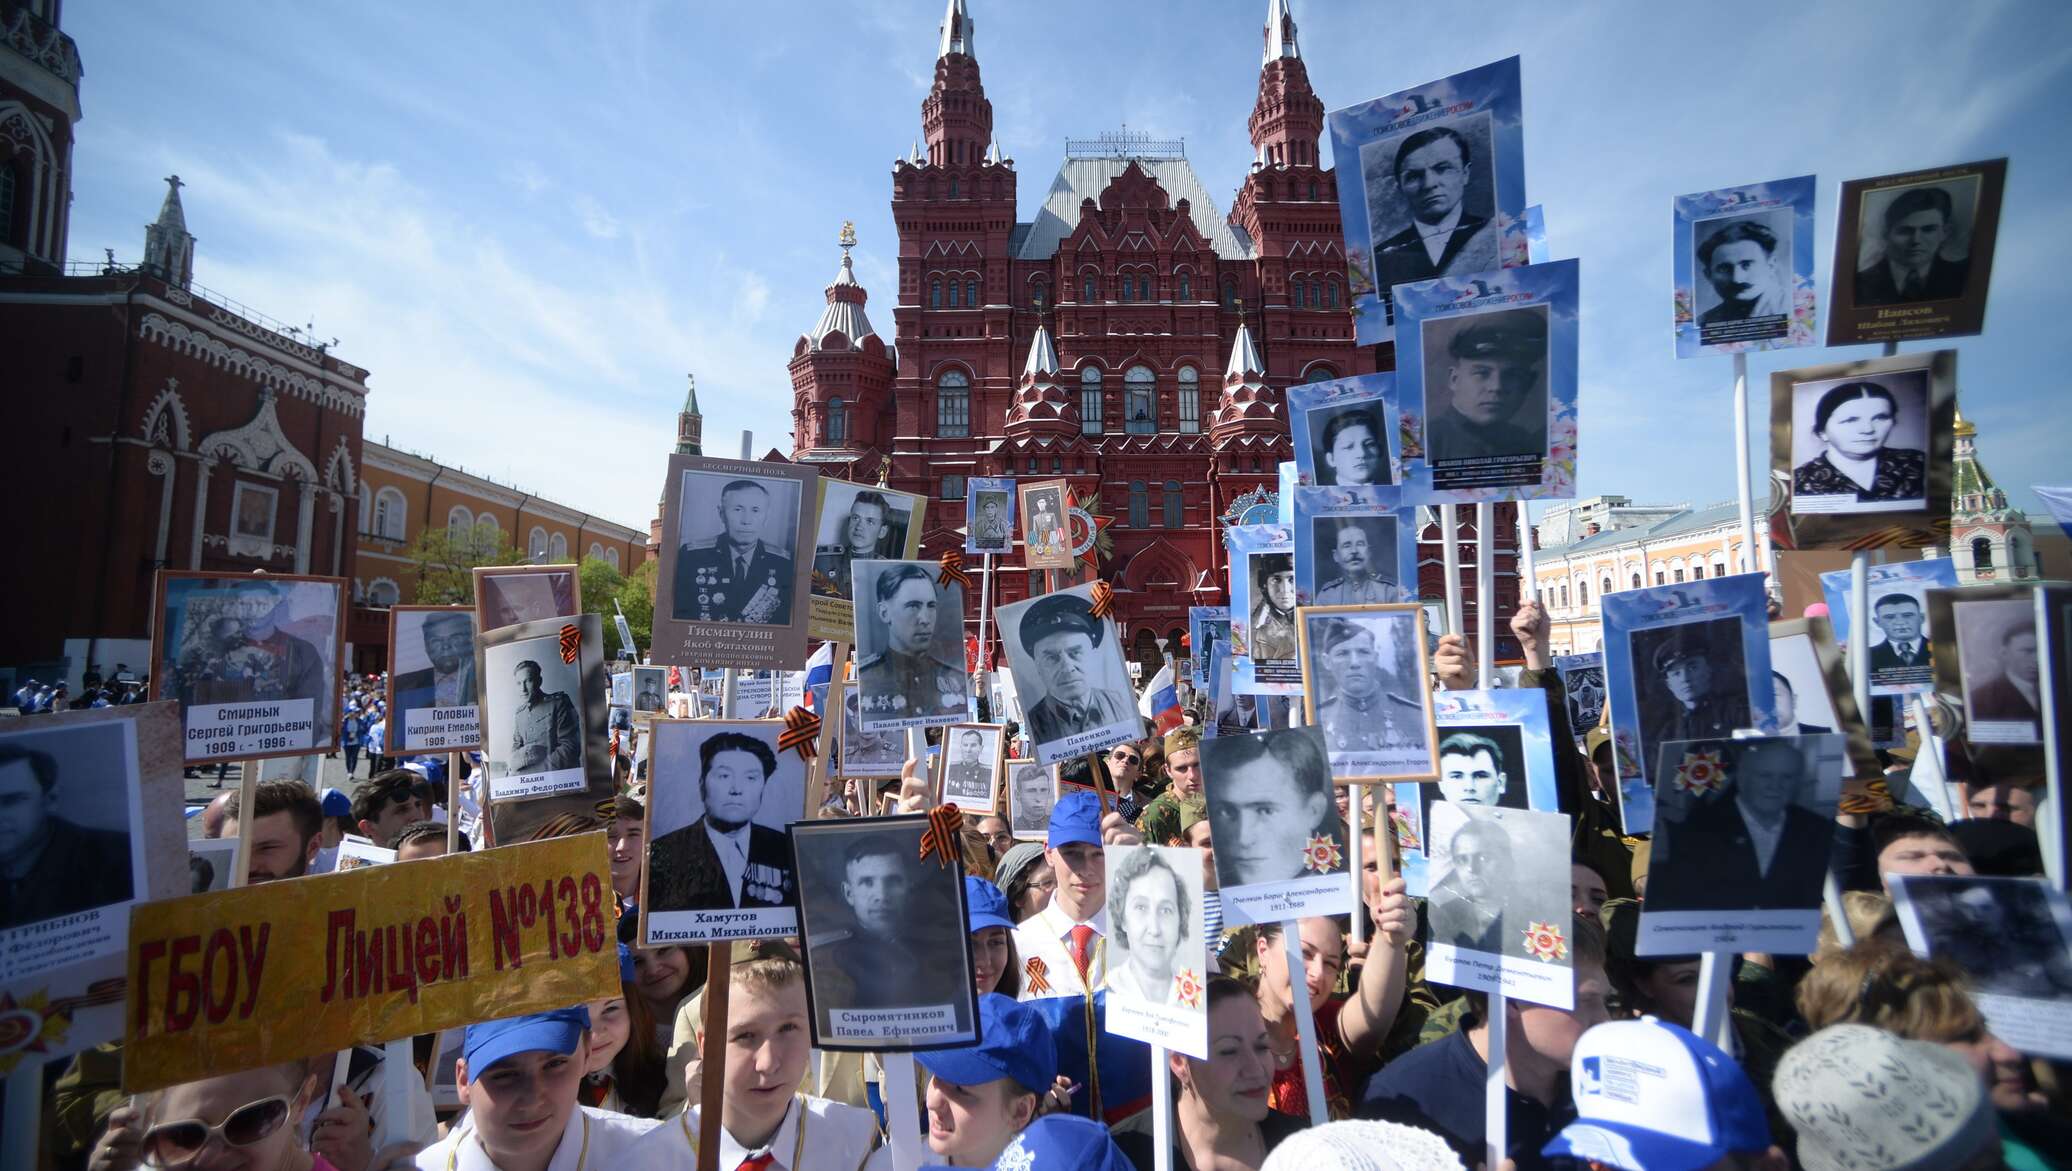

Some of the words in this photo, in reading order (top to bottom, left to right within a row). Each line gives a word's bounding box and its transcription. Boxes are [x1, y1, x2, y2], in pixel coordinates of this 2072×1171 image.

[687, 624, 775, 640] Гисматулин
[218, 706, 280, 721] Смирных
[432, 708, 475, 721] Головин
[188, 724, 235, 740] Сергей
[238, 721, 313, 737] Григорьевич
[205, 741, 236, 754] 1909
[257, 737, 287, 749] 1996
[424, 736, 446, 747] 1909
[695, 913, 758, 925] Хамутов
[320, 894, 468, 1005] Лицей
[488, 872, 606, 971] №138
[651, 928, 707, 941] Михаил
[711, 925, 798, 938] Михайлович
[137, 921, 271, 1040] ГБОУ
[841, 1010, 945, 1024] Сыромятников
[836, 1026, 875, 1037] Павел
[882, 1023, 955, 1038] Ефимович
